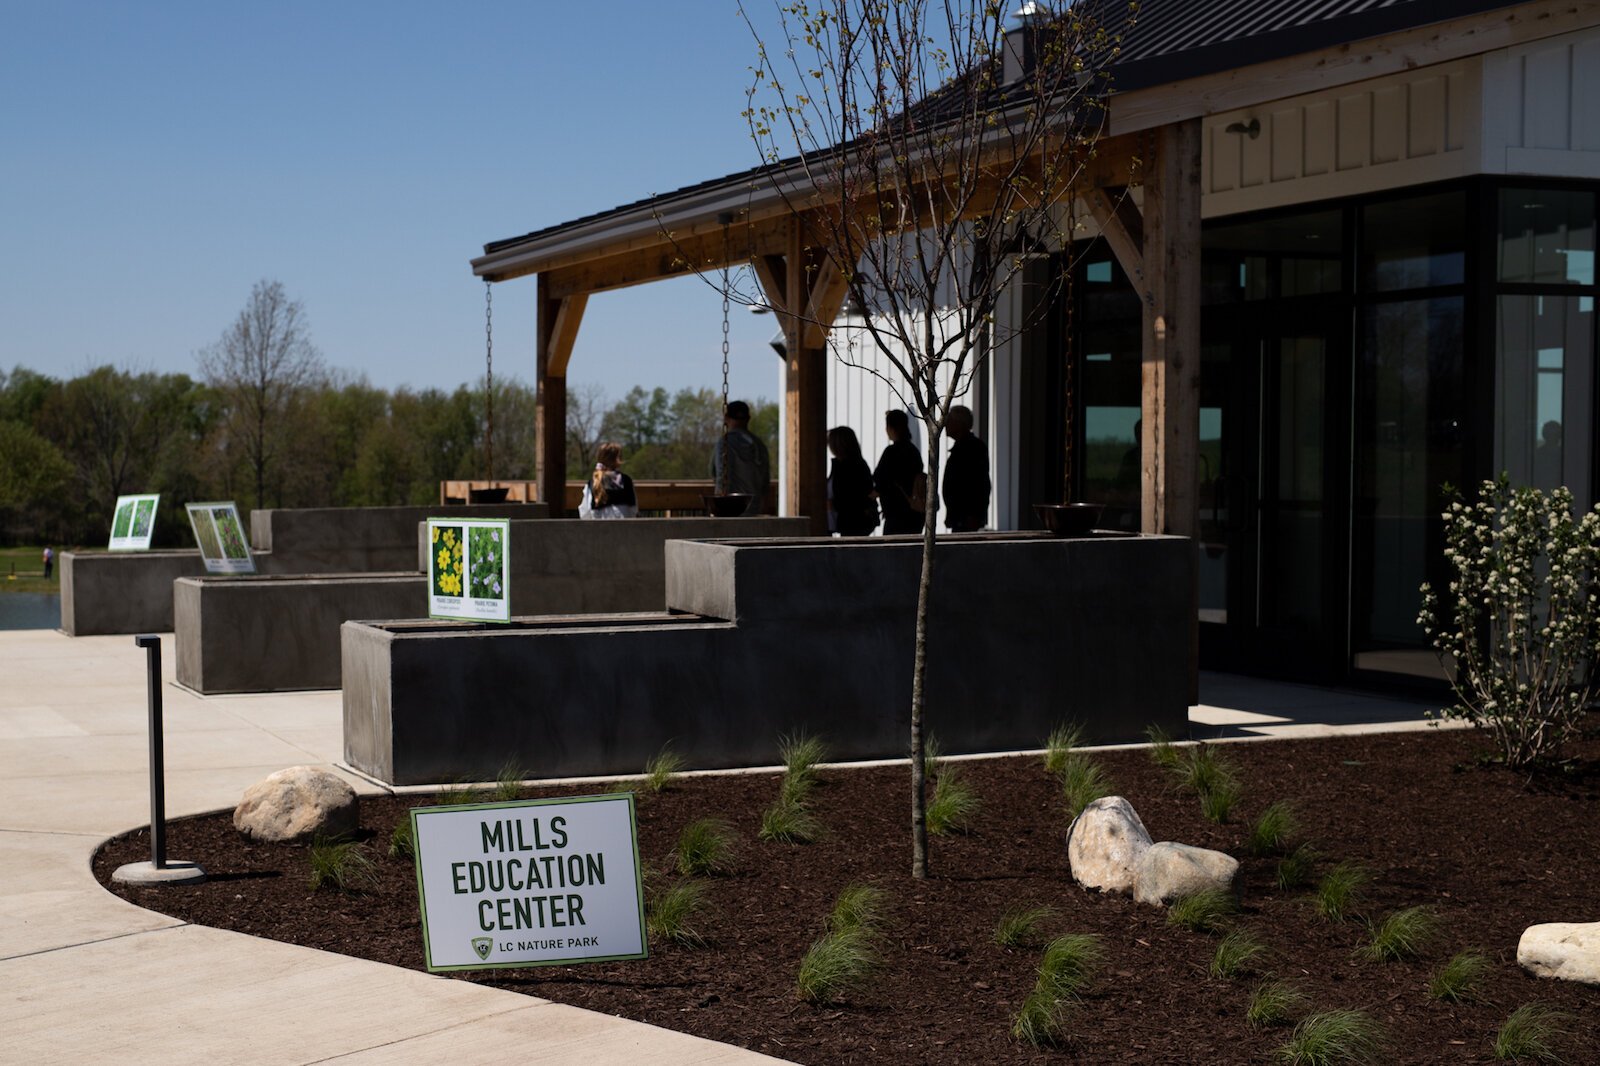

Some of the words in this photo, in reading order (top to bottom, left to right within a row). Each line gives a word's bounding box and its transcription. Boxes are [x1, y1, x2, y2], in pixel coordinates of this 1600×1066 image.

[481, 816, 569, 854] MILLS
[451, 852, 606, 895] EDUCATION
[478, 894, 587, 932] CENTER
[499, 942, 514, 952] LC
[517, 938, 564, 951] NATURE
[568, 936, 599, 948] PARK
